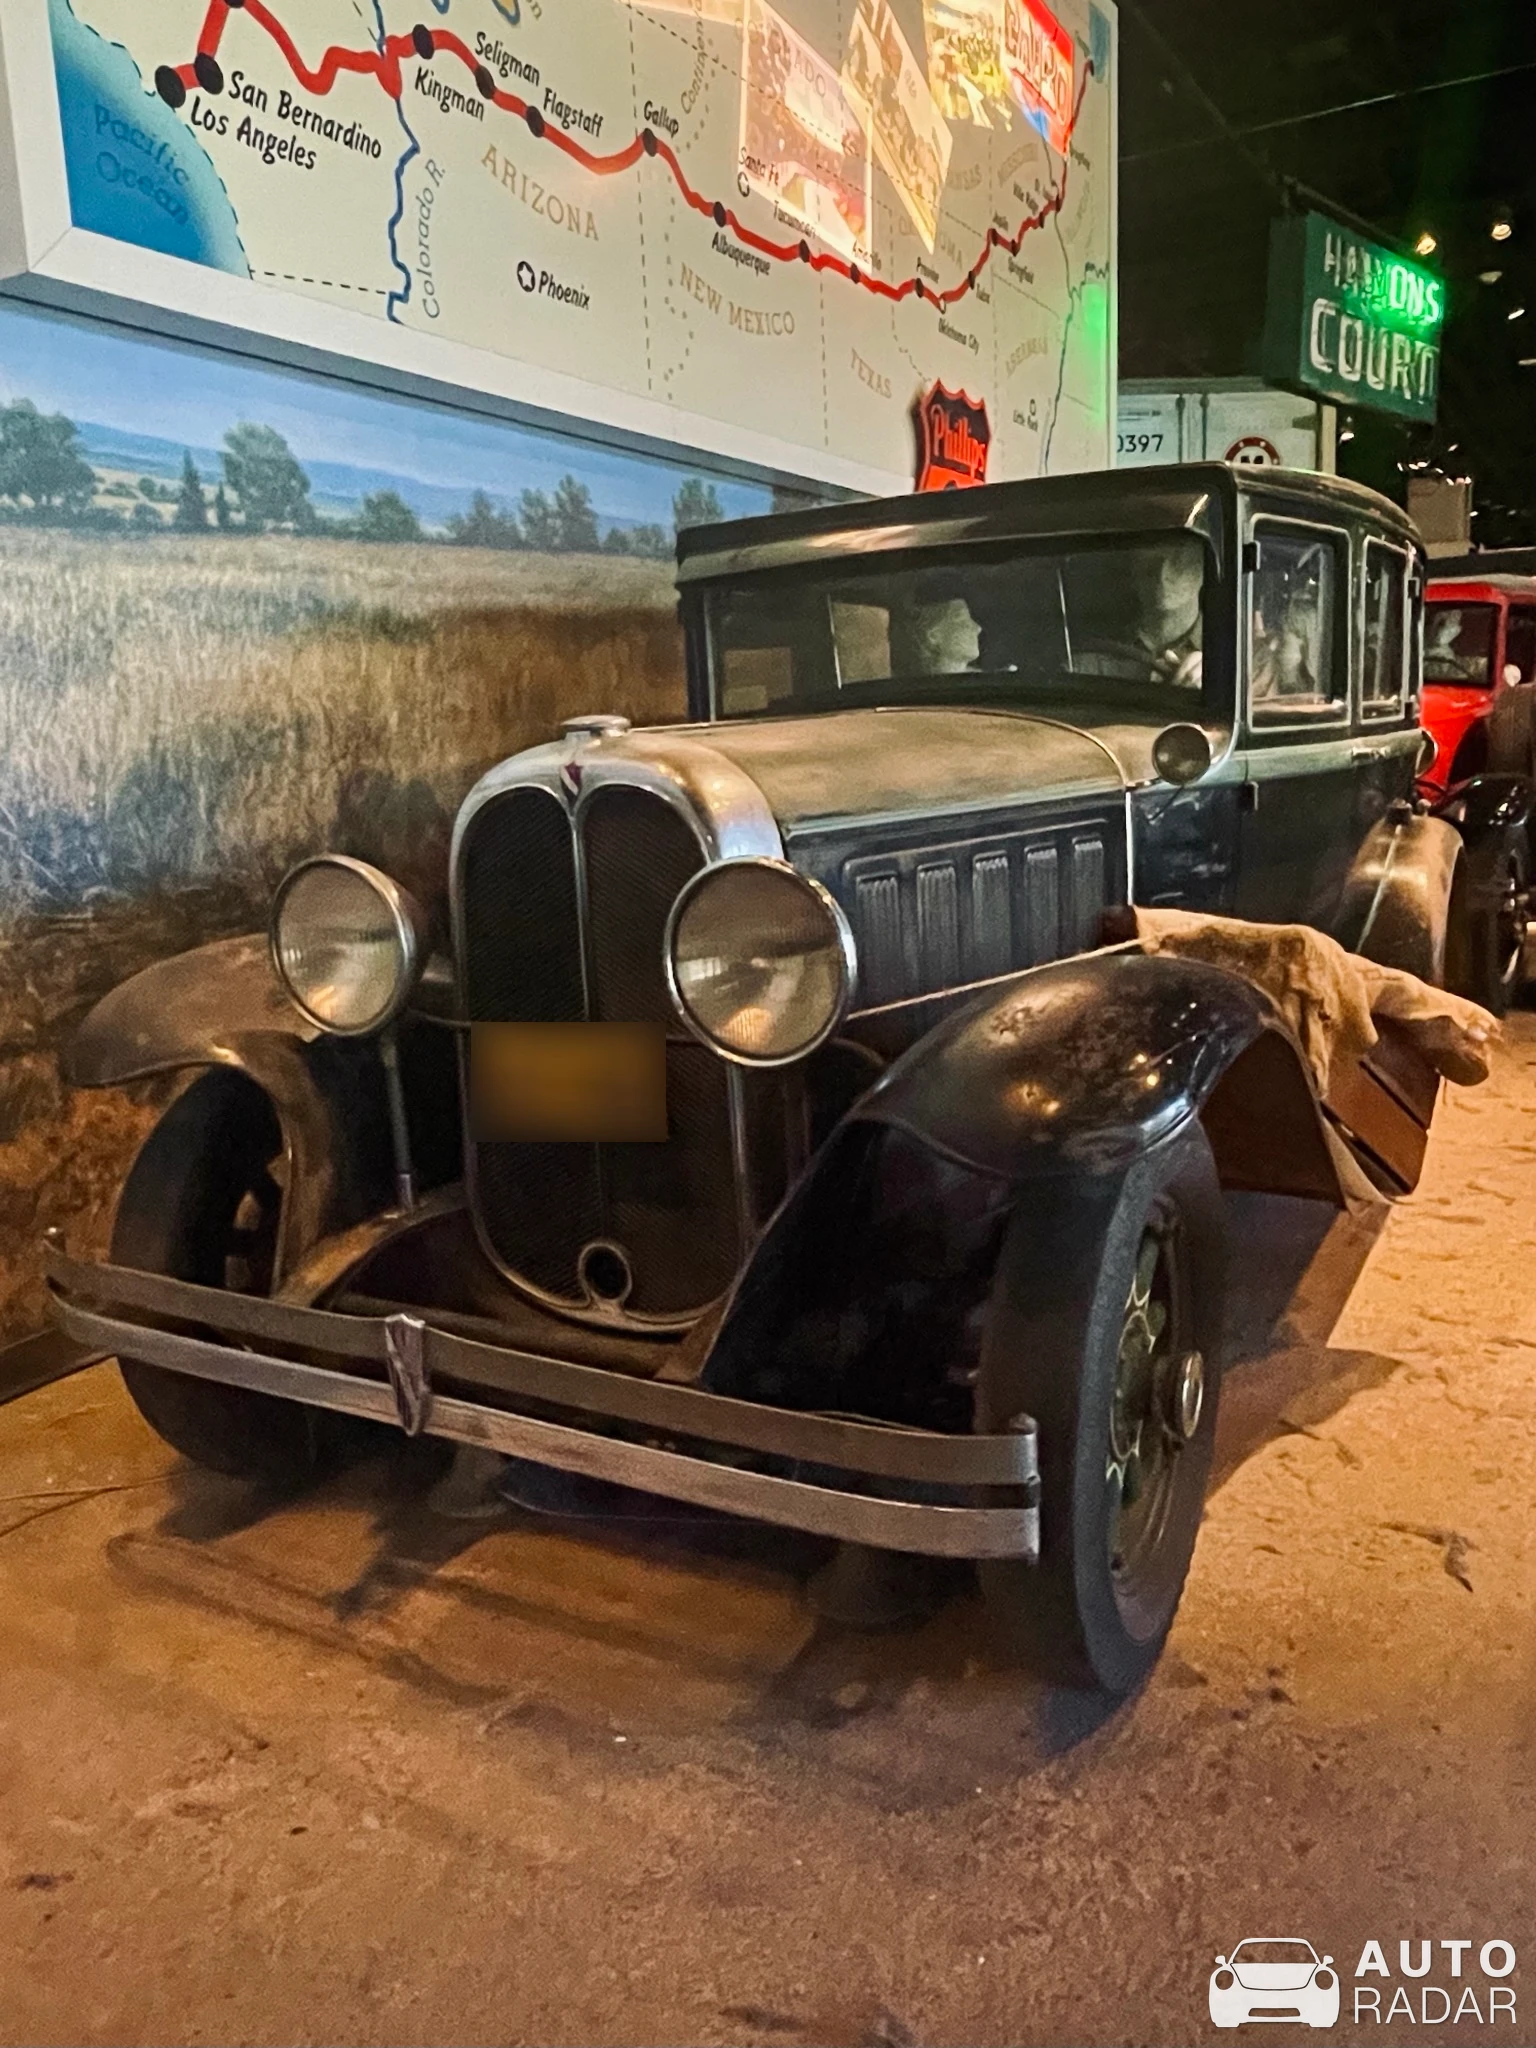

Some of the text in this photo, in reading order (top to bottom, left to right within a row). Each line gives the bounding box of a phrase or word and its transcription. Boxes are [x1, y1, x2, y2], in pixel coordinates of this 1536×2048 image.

[414, 66, 485, 122] Kingman
[474, 31, 541, 87] Seligman
[94, 101, 190, 185] Pacific
[190, 96, 317, 170] Los Angeles
[228, 70, 382, 159] San Bernardino
[543, 87, 604, 138] Flagstaff
[643, 100, 680, 138] Gallup
[95, 151, 189, 224] Ocean
[481, 144, 600, 242] ARIZONA
[738, 147, 766, 177] Santa
[416, 159, 447, 319] Colorado R.
[711, 231, 771, 277] Albuquerque
[538, 270, 591, 311] Phoenix
[680, 261, 795, 336] NEW MEXICO
[850, 347, 893, 399] TEXAS
[1310, 297, 1440, 404] COURT
[930, 403, 986, 479] Phillips
